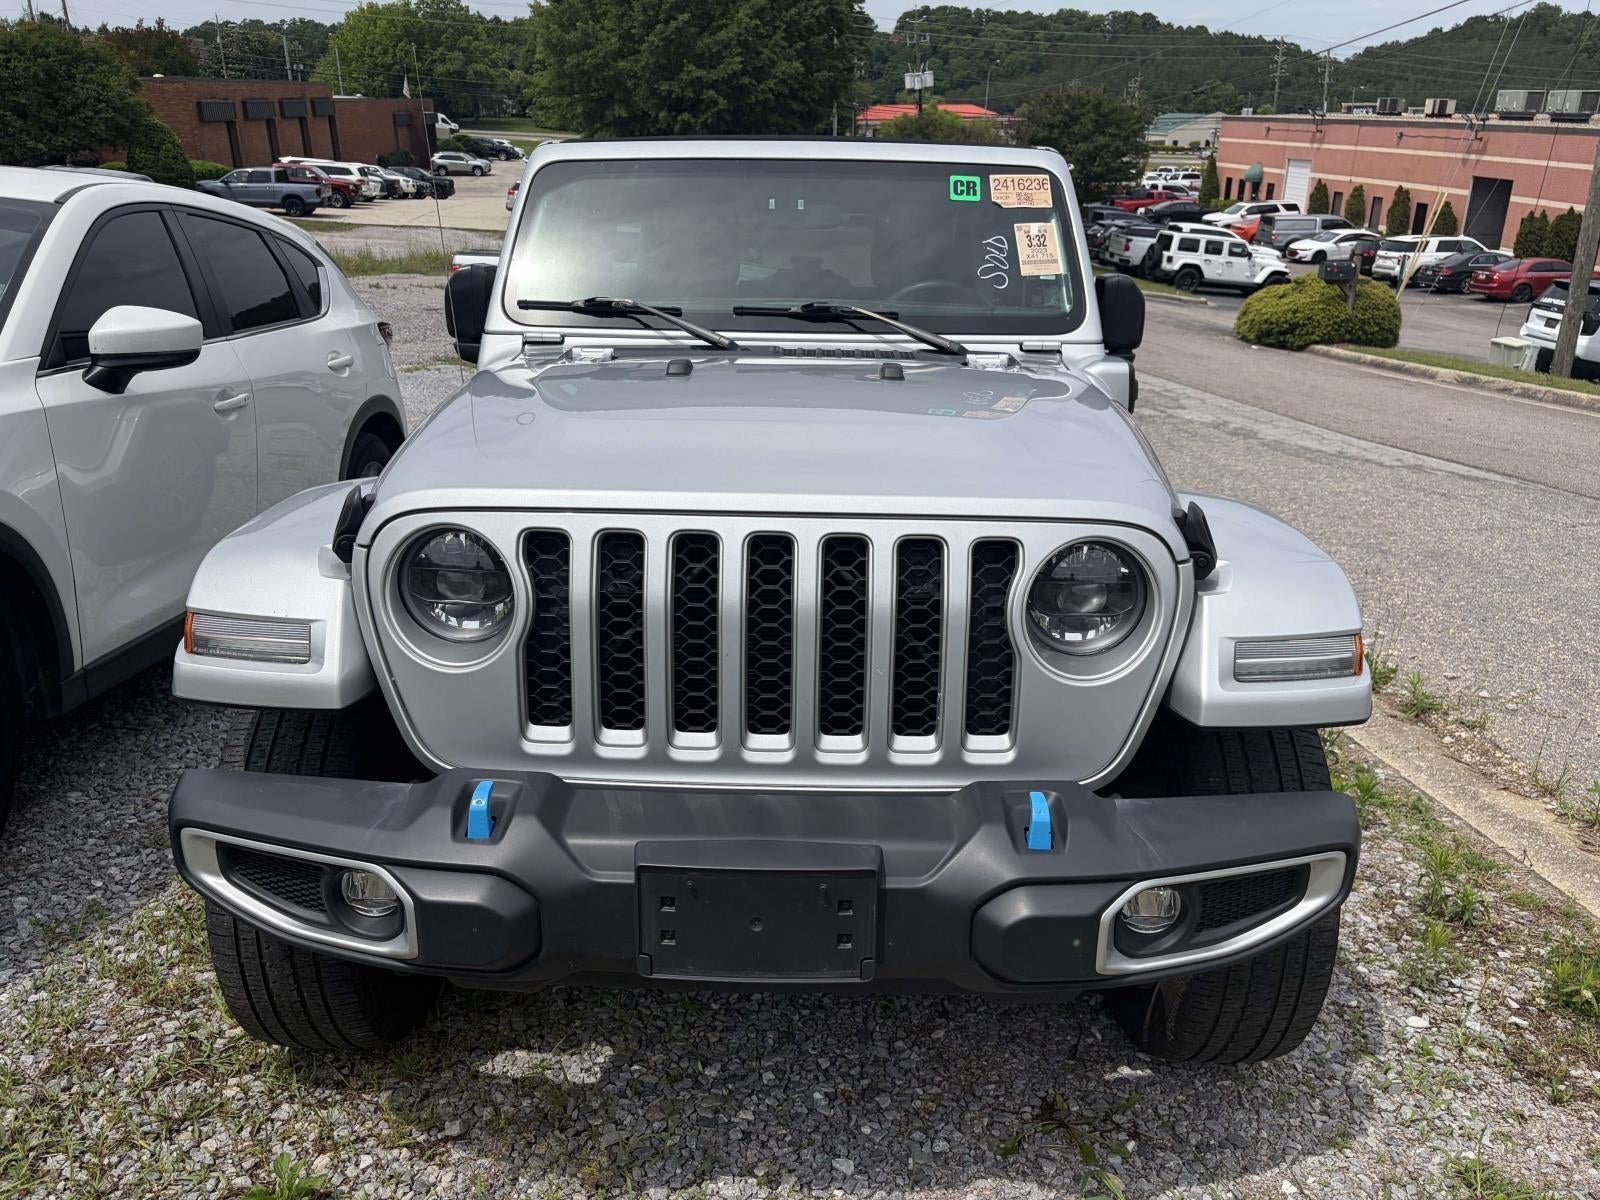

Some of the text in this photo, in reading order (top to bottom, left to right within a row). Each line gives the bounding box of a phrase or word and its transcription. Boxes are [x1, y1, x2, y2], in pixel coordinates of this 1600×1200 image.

[953, 180, 977, 196] CR
[992, 178, 1049, 191] 2416236
[1026, 234, 1048, 248] 3:32
